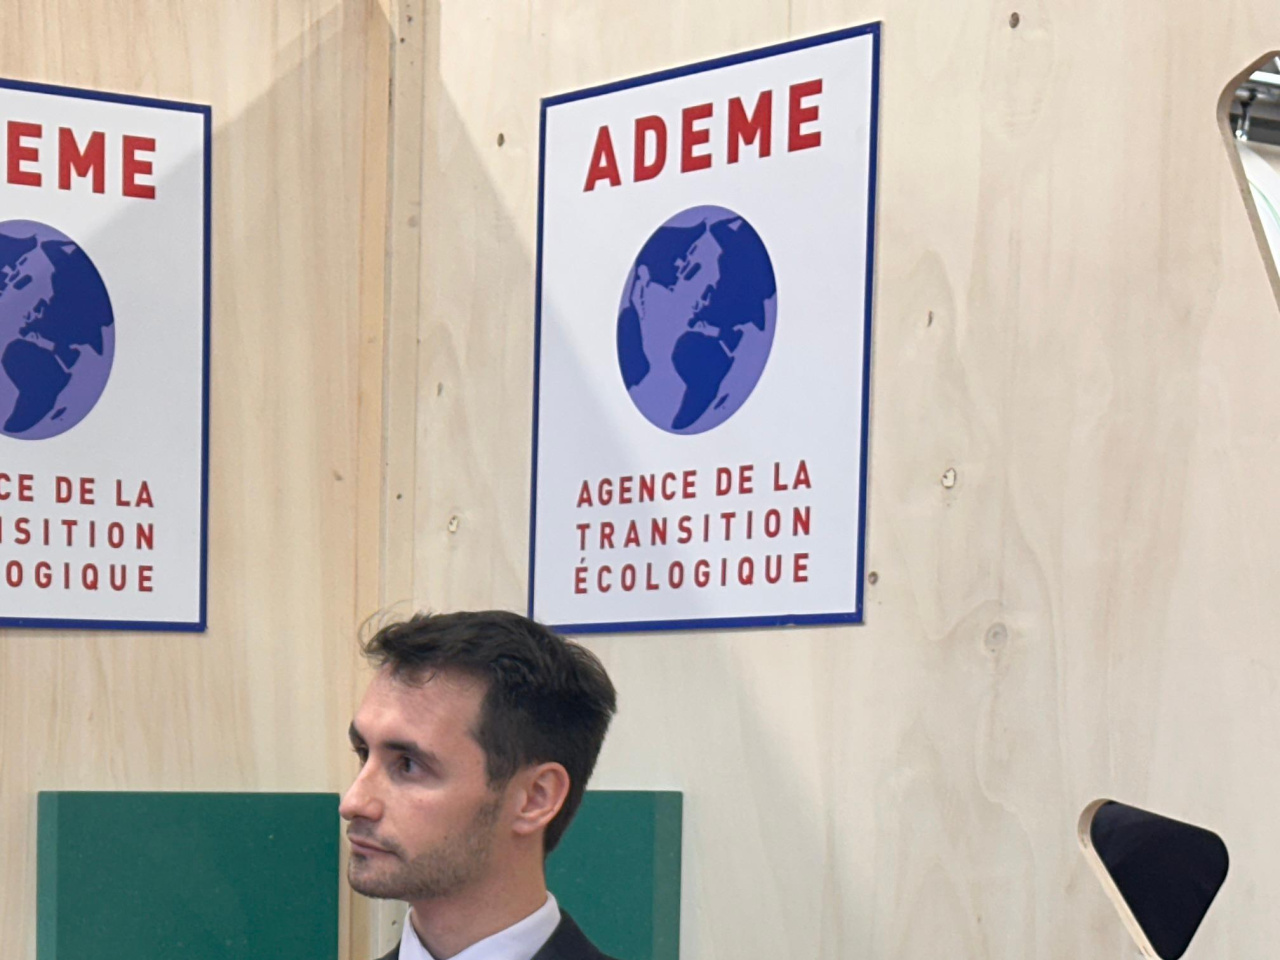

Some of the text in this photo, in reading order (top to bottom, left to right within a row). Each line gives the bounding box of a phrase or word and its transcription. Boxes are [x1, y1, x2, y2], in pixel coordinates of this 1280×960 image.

[583, 78, 823, 193] ADEME
[55, 476, 95, 505] DE
[116, 479, 154, 508] LA
[576, 460, 812, 508] AGENCE DE LA
[576, 506, 811, 551] TRANSITION
[574, 553, 809, 594] ÉCOLOGIQUE
